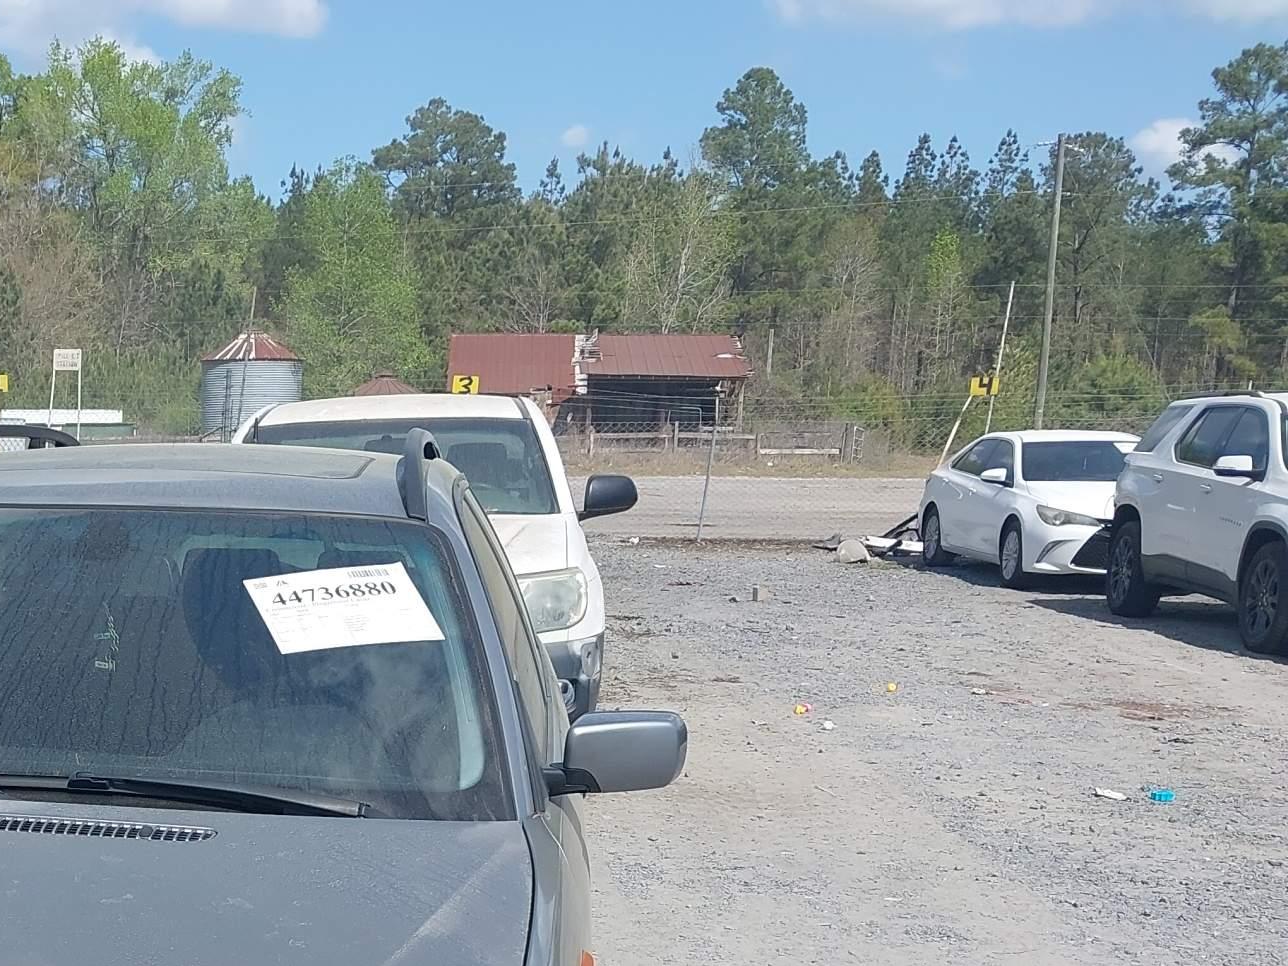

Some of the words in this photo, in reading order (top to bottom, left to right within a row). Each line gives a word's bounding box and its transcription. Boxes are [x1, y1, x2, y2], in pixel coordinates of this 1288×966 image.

[458, 376, 474, 393] 3
[978, 376, 994, 395] 4
[272, 580, 397, 606] 44736880
